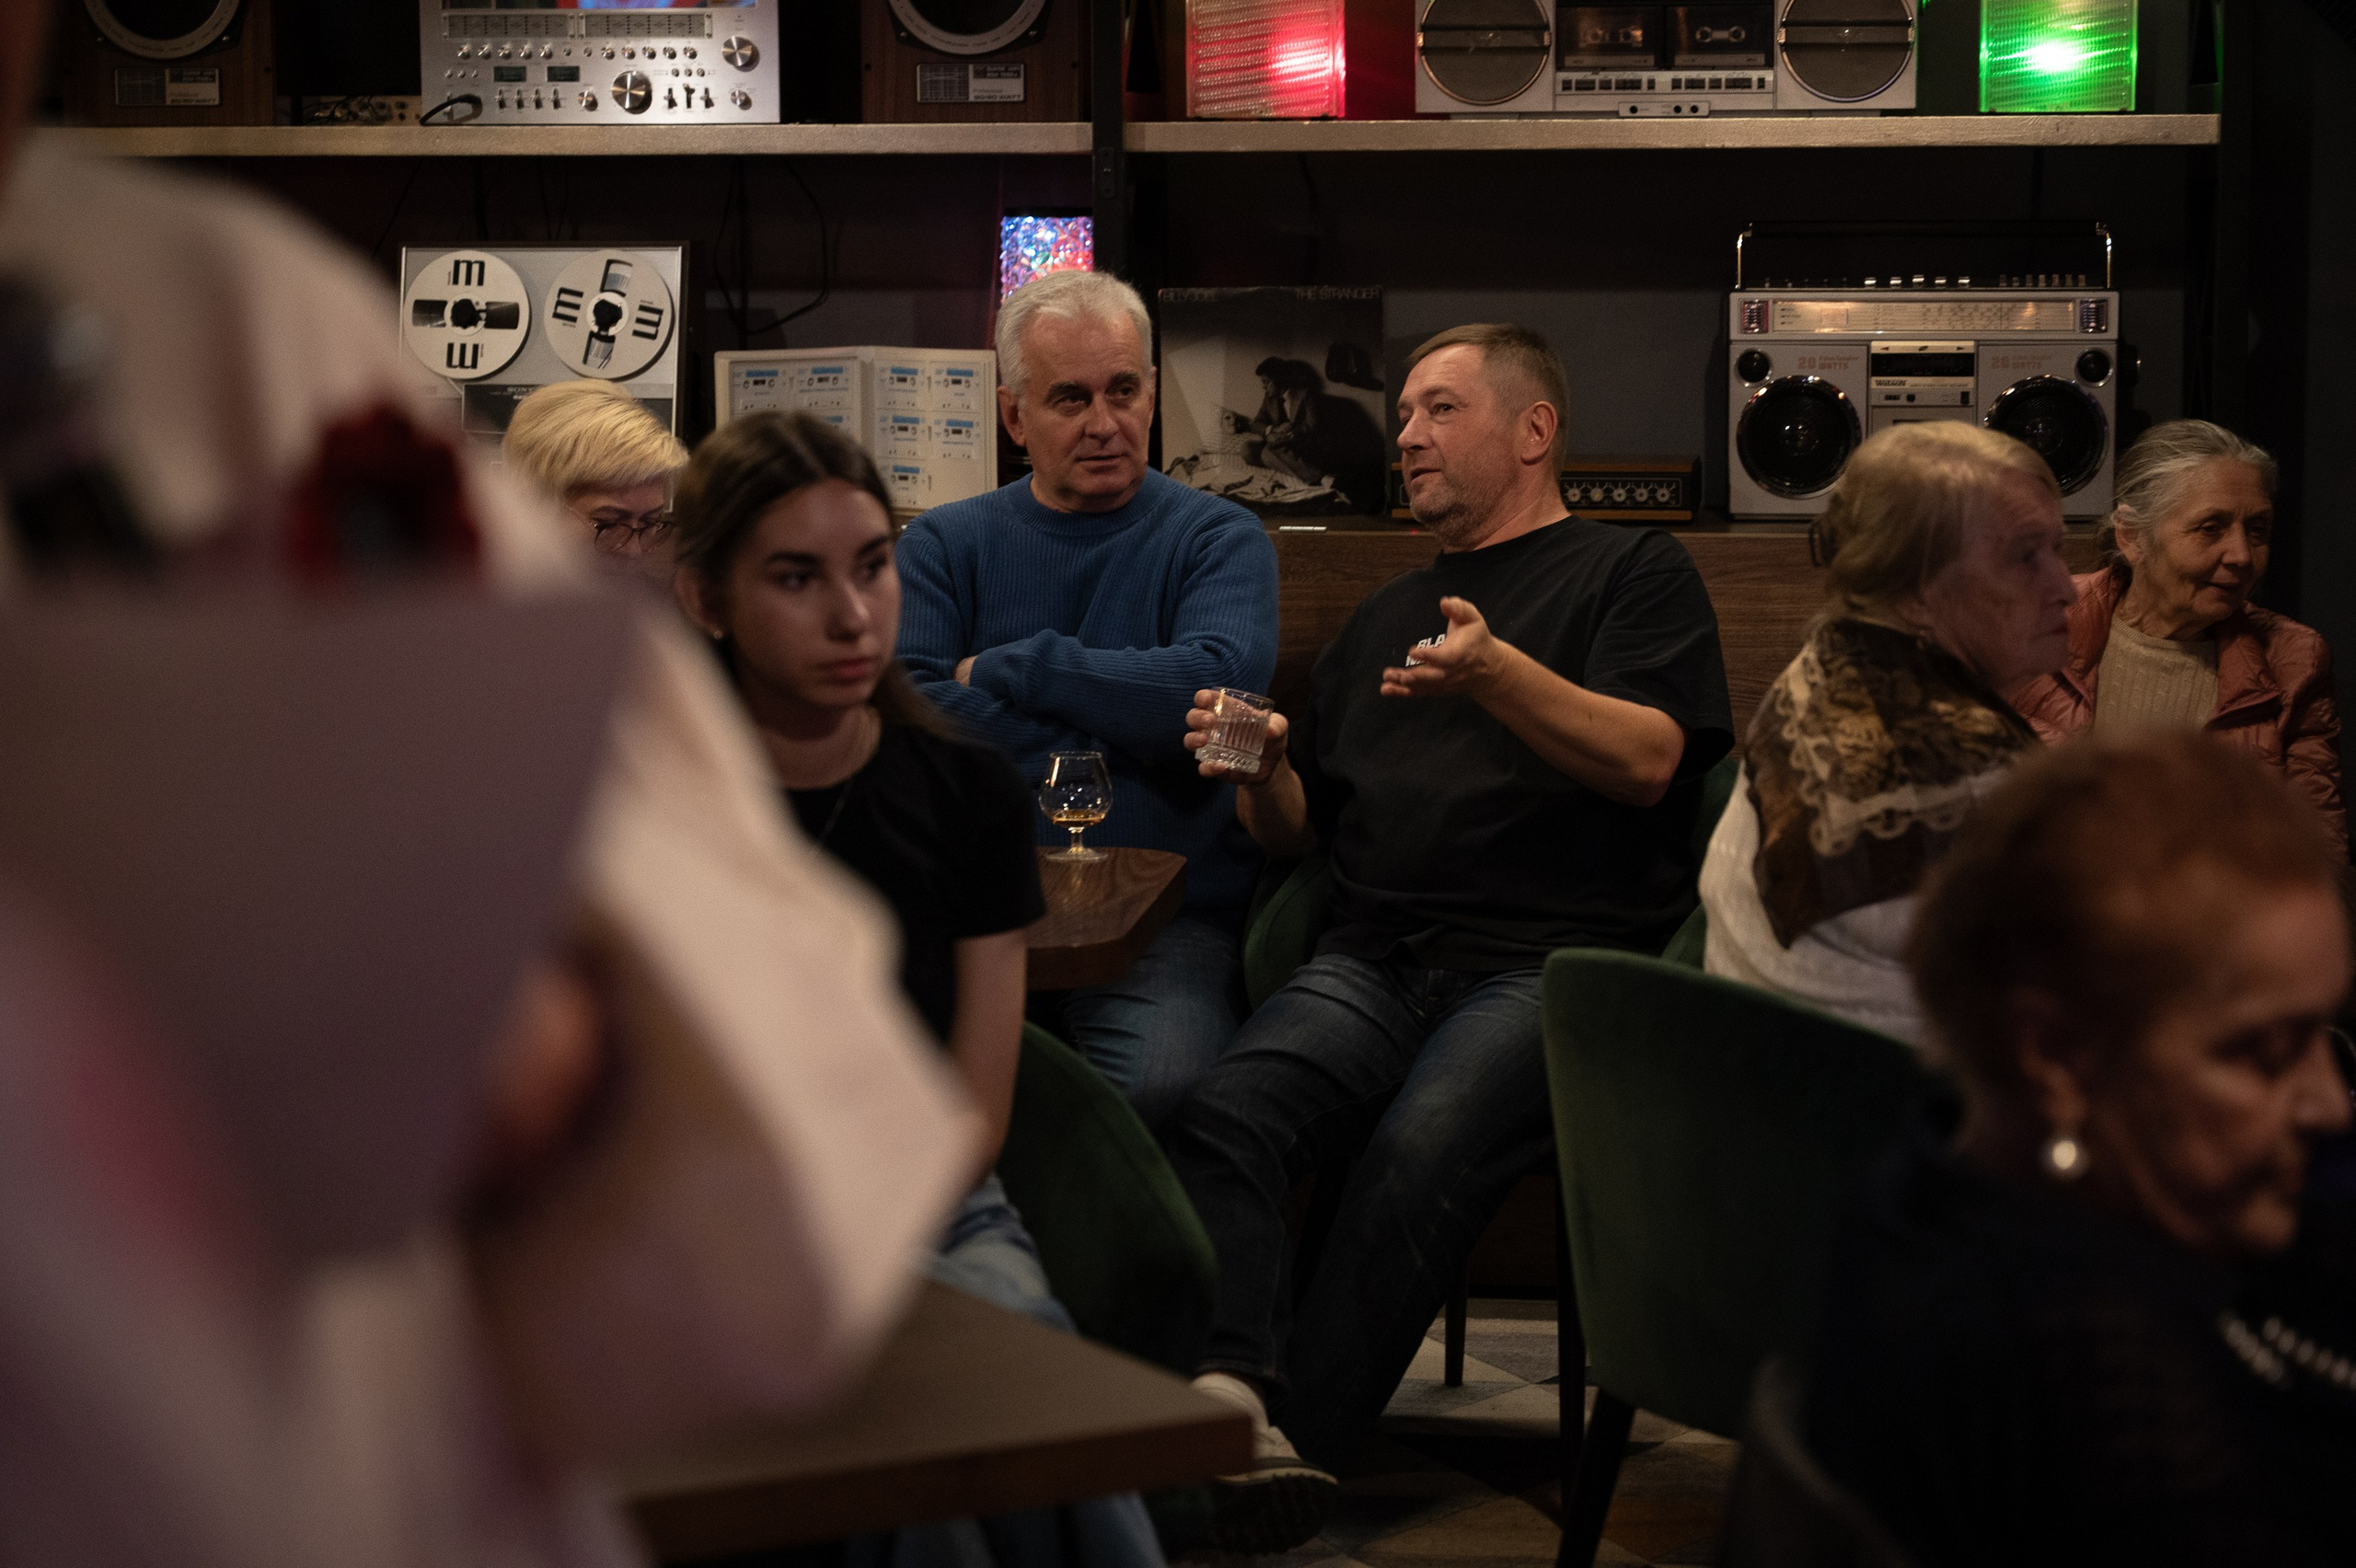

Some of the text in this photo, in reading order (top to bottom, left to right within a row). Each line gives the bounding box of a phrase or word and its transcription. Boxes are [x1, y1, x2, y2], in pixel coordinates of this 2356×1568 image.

[1295, 285, 1380, 301] THE STRANGER
[1797, 356, 1817, 370] 20
[1819, 362, 1849, 370] WATTS
[2012, 362, 2042, 370] WATTS
